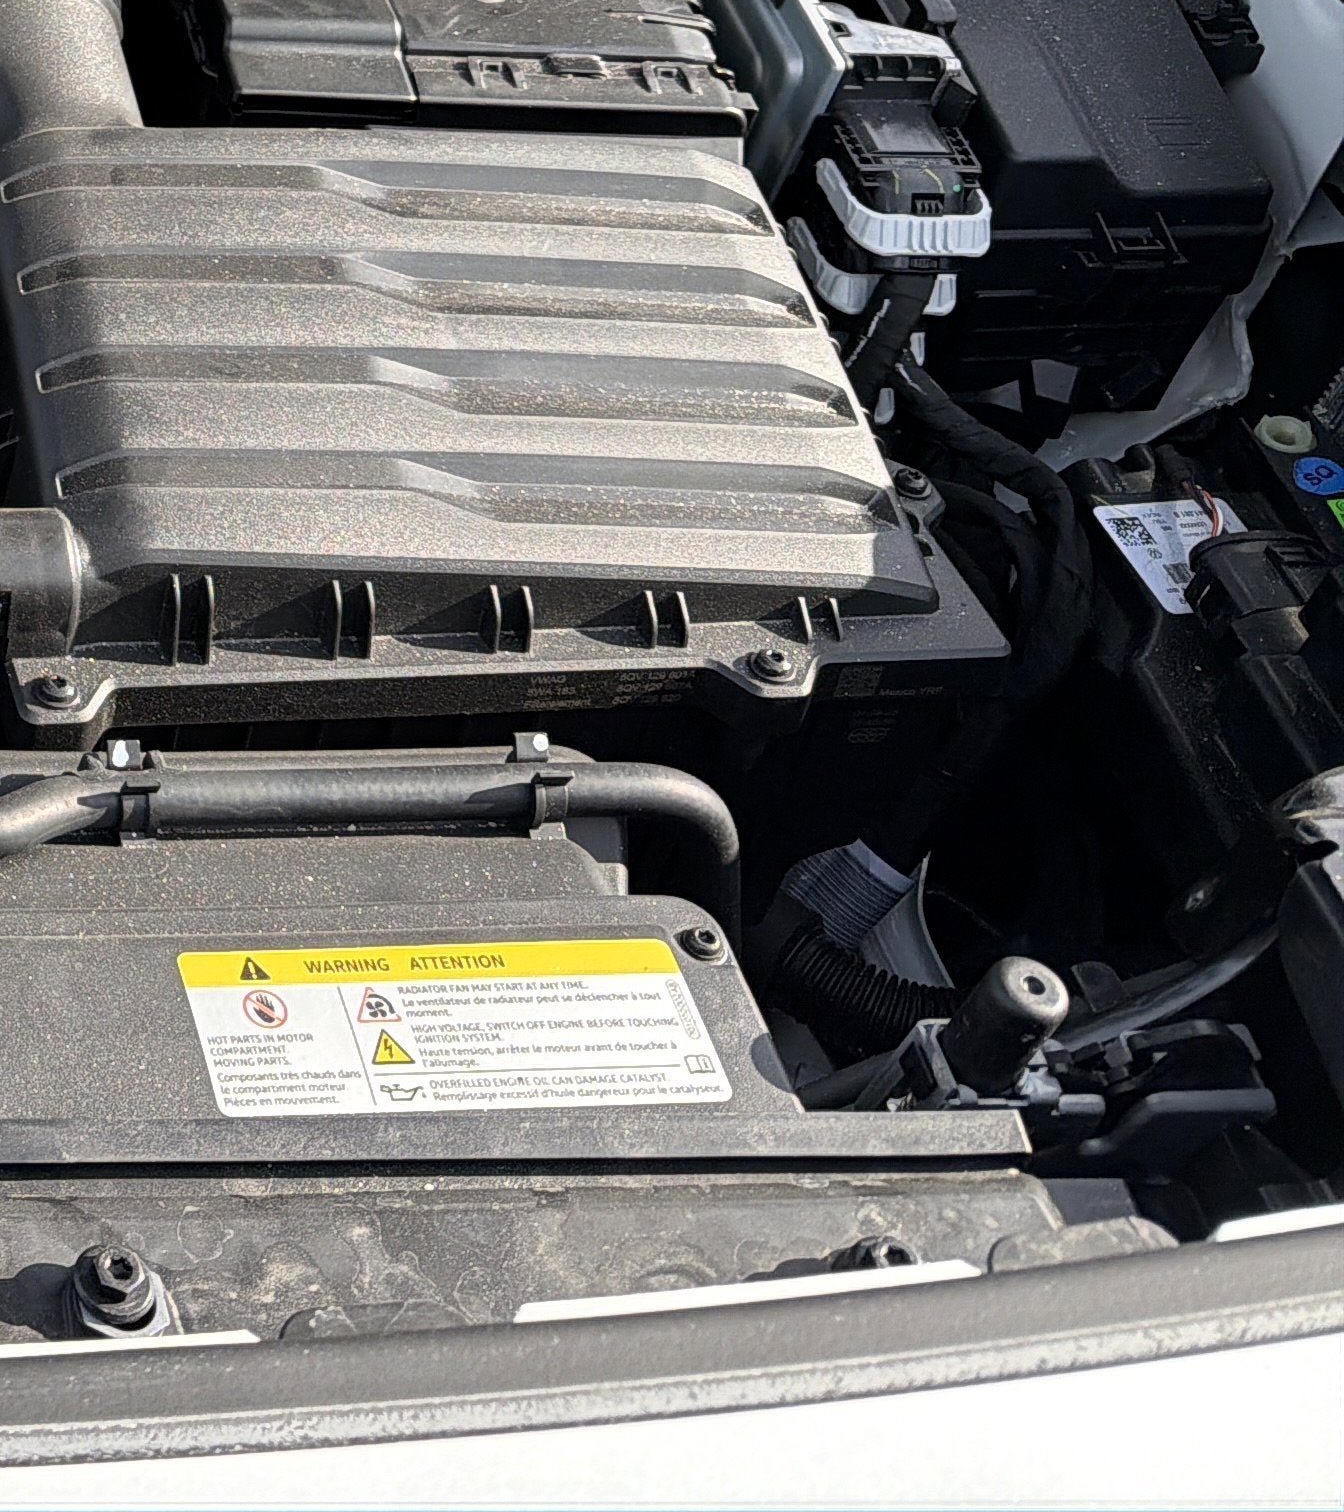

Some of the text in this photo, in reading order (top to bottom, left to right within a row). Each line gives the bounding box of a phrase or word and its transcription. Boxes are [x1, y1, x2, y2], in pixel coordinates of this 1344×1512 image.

[303, 954, 506, 974] WARNING ATTENTION
[397, 985, 448, 995] RADIATOR
[449, 984, 469, 993] FAN
[471, 983, 492, 992] MAY
[494, 982, 524, 991] START
[526, 982, 537, 990] AT
[473, 995, 487, 1005] de
[536, 995, 560, 1005] peut
[639, 991, 661, 1000] tout
[486, 1021, 525, 1031] SWITCH
[526, 1020, 546, 1030] OFF
[548, 1019, 585, 1029] ENGINE
[587, 1019, 625, 1028] BEFORE
[627, 1017, 680, 1026] TOUCHING
[207, 1035, 227, 1045] HOT
[229, 1034, 260, 1044] PARTS
[277, 1033, 313, 1043] MOTOR
[414, 1034, 460, 1044] IGNITION
[419, 1047, 450, 1057] Haute
[532, 1044, 543, 1053] le
[544, 1043, 581, 1053] moteur
[615, 1042, 627, 1051] de
[213, 1057, 256, 1067] MOVING
[217, 1071, 279, 1084] Composants
[280, 1070, 299, 1080] très
[338, 1068, 362, 1079] dans
[553, 1075, 573, 1085] CAN
[575, 1074, 617, 1084] DAMAGE
[224, 1095, 257, 1107] Pièces
[259, 1097, 273, 1106] en
